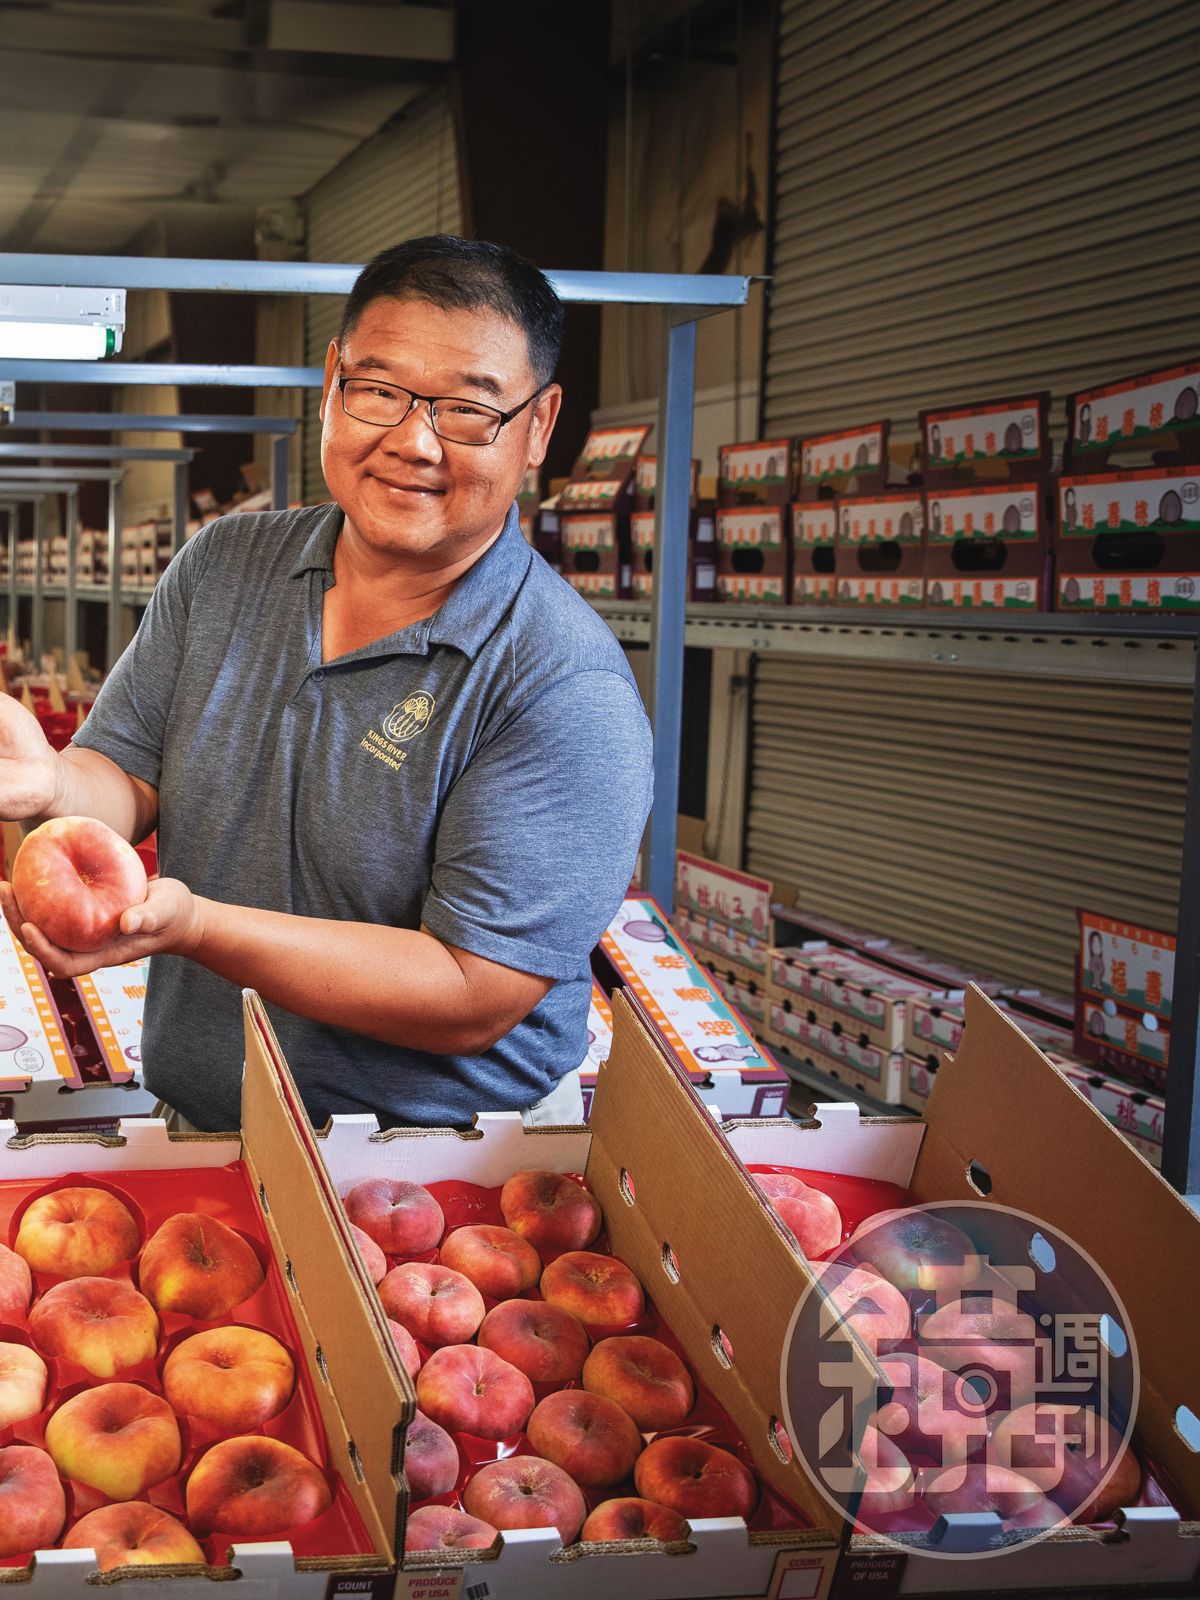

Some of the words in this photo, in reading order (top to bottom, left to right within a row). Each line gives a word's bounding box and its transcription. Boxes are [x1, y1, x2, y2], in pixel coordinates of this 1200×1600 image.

[367, 729, 389, 749] KINGS
[386, 742, 408, 762] RIVER
[360, 738, 402, 771] Incorporated
[651, 954, 739, 1038] 福壽桃
[788, 1557, 824, 1568] COUNT
[850, 1559, 897, 1569] PRODUCE
[853, 1572, 866, 1581] OF
[868, 1571, 888, 1580] USA
[337, 1580, 374, 1591] COUNT
[408, 1576, 458, 1588] PRODUCE
[412, 1590, 426, 1599] OF
[428, 1589, 449, 1598] USA
